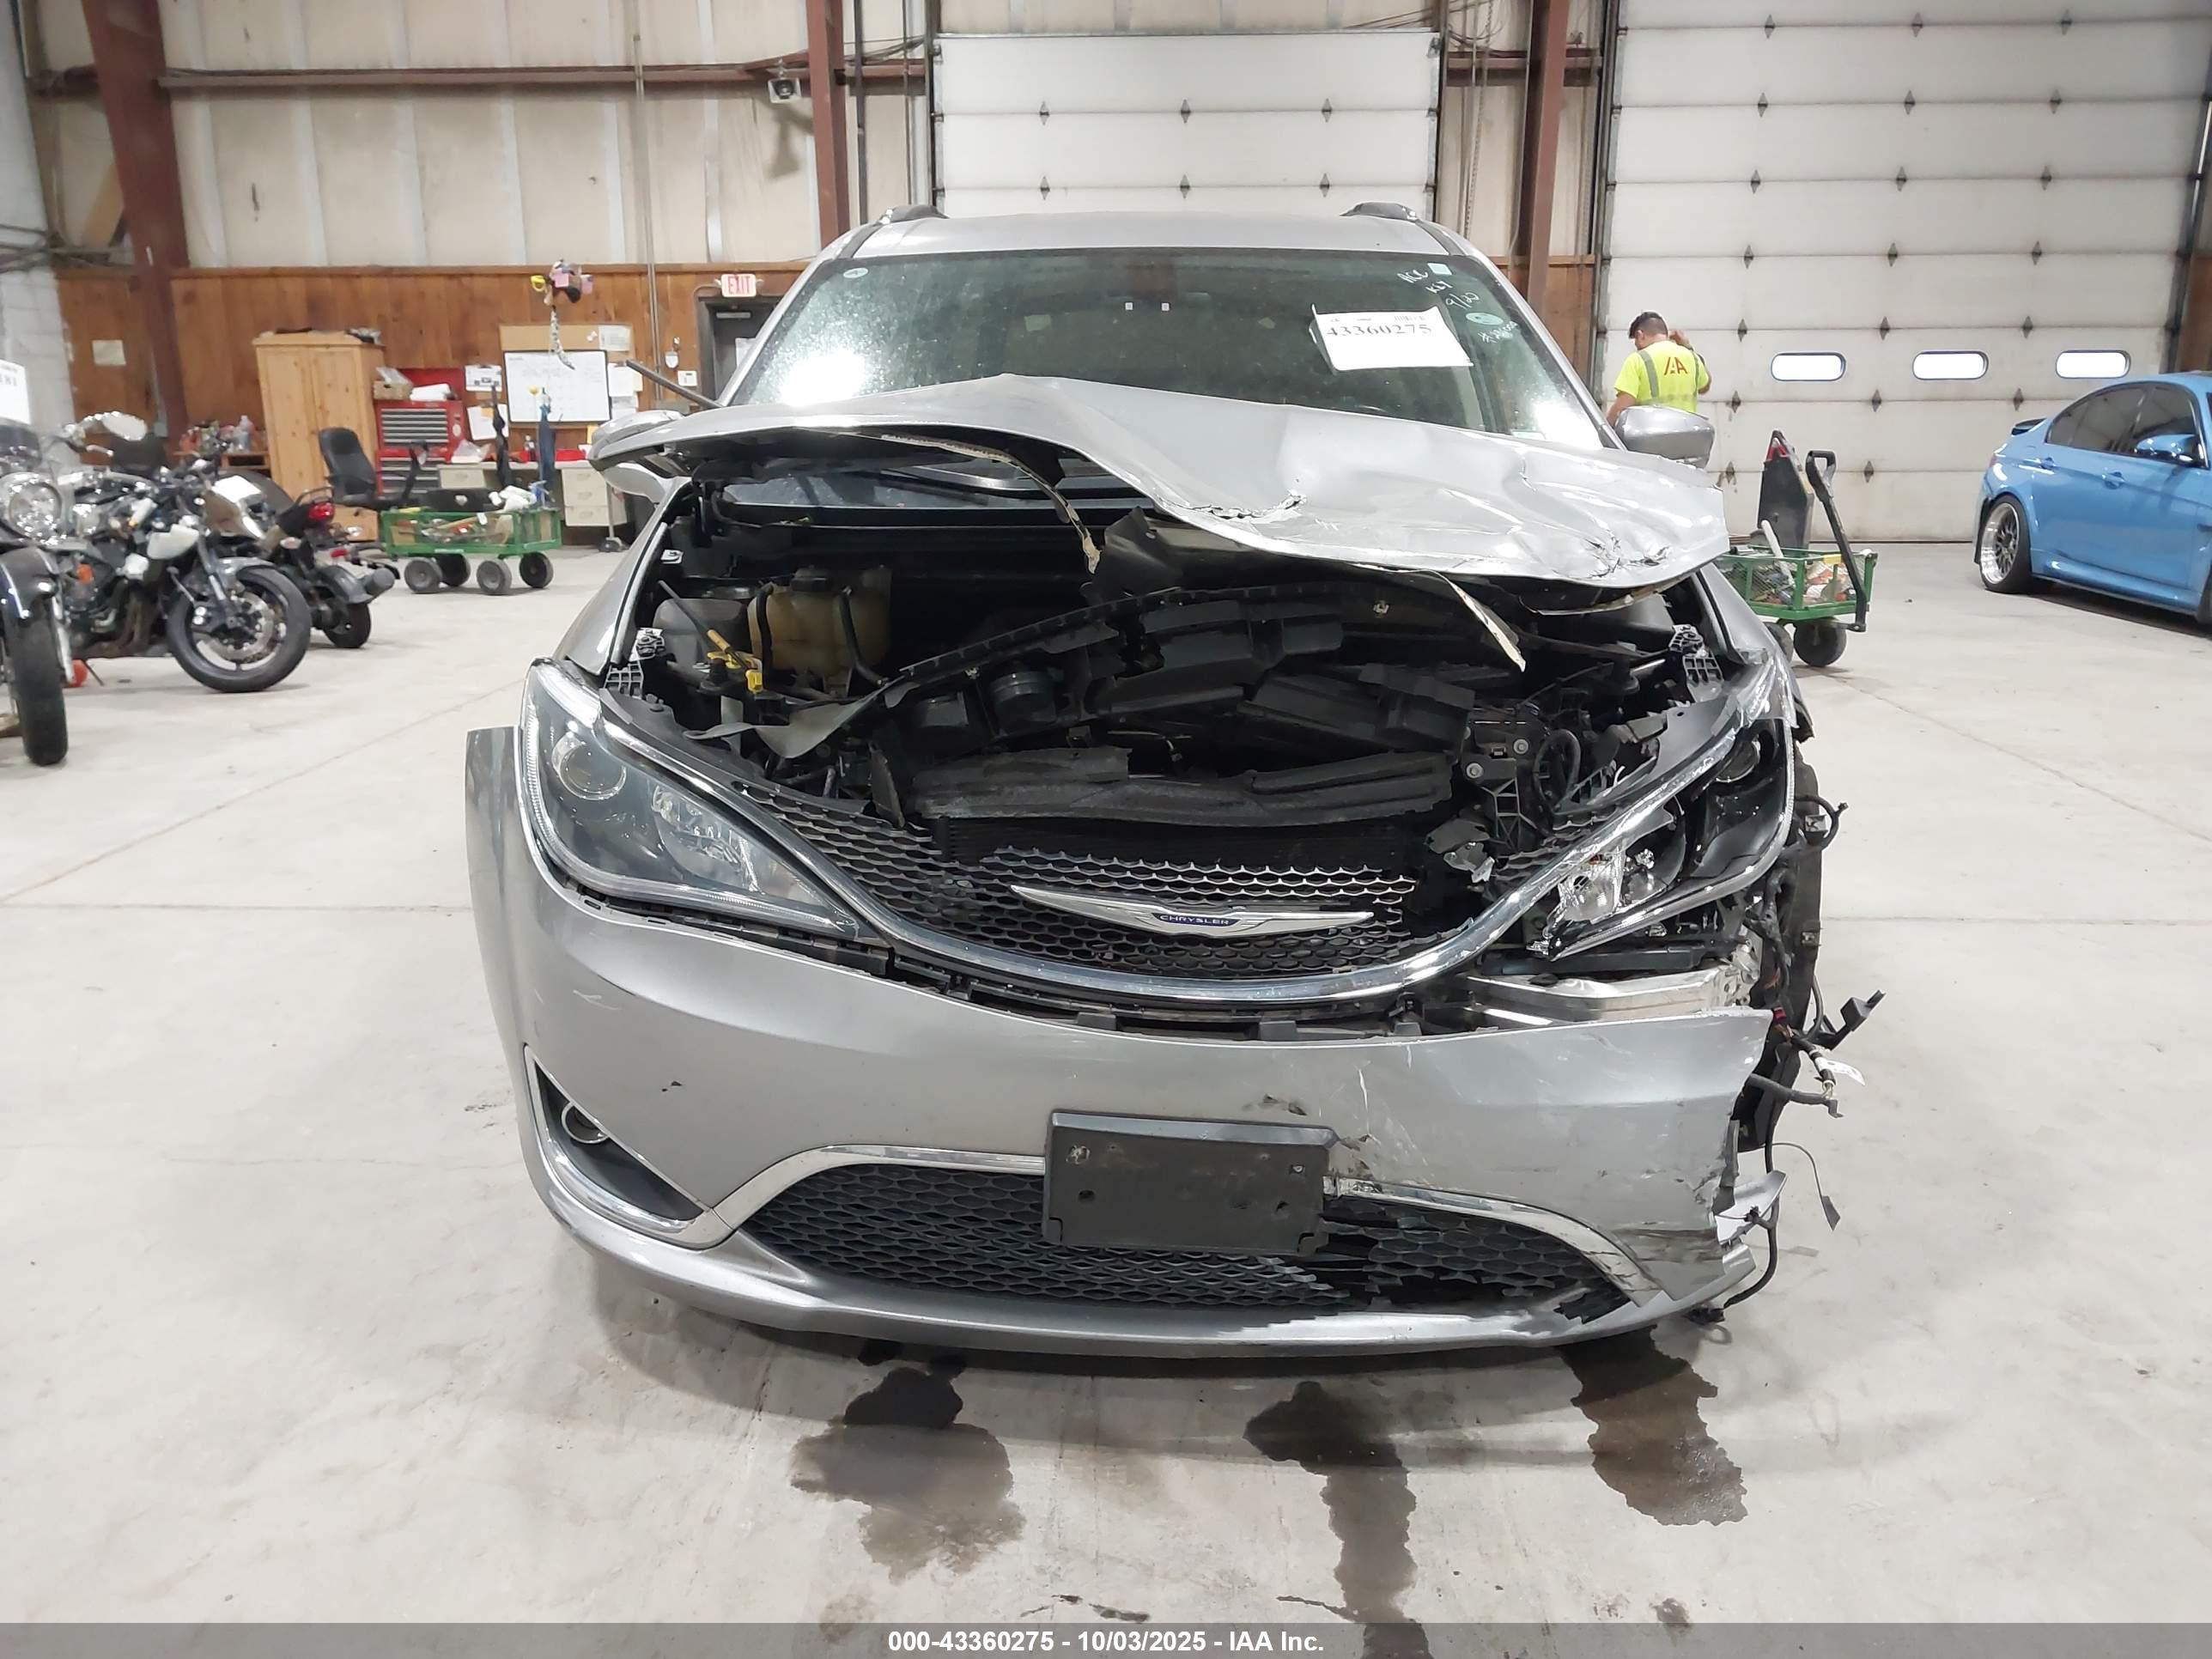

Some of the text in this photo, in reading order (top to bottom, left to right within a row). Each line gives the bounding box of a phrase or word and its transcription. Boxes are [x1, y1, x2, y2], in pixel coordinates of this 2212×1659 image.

[727, 275, 750, 295] EXIT
[1326, 324, 1432, 337] 43360275
[1159, 915, 1230, 925] CHRYSLER
